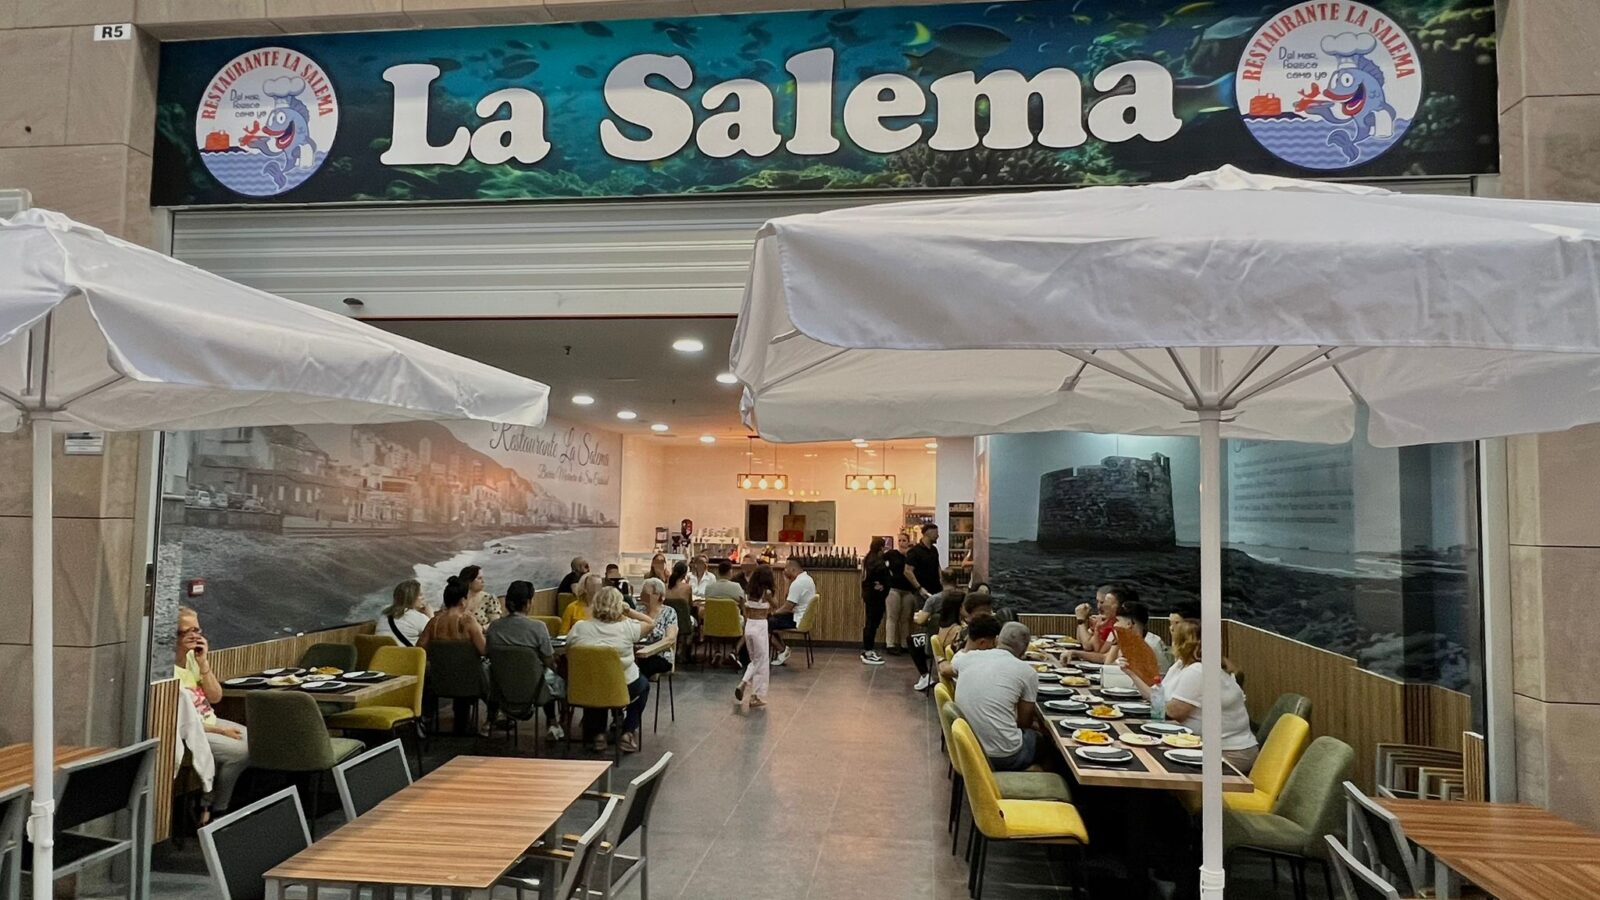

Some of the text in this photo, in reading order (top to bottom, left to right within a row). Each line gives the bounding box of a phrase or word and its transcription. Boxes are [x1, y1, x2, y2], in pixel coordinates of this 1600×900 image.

[102, 25, 123, 38] R5
[1242, 3, 1417, 82] RESTAURANTE LA SALEMA
[201, 50, 334, 120] RESTAURANTE LA SALEMA
[380, 47, 1182, 165] La Salema
[490, 423, 558, 458] Restaurante
